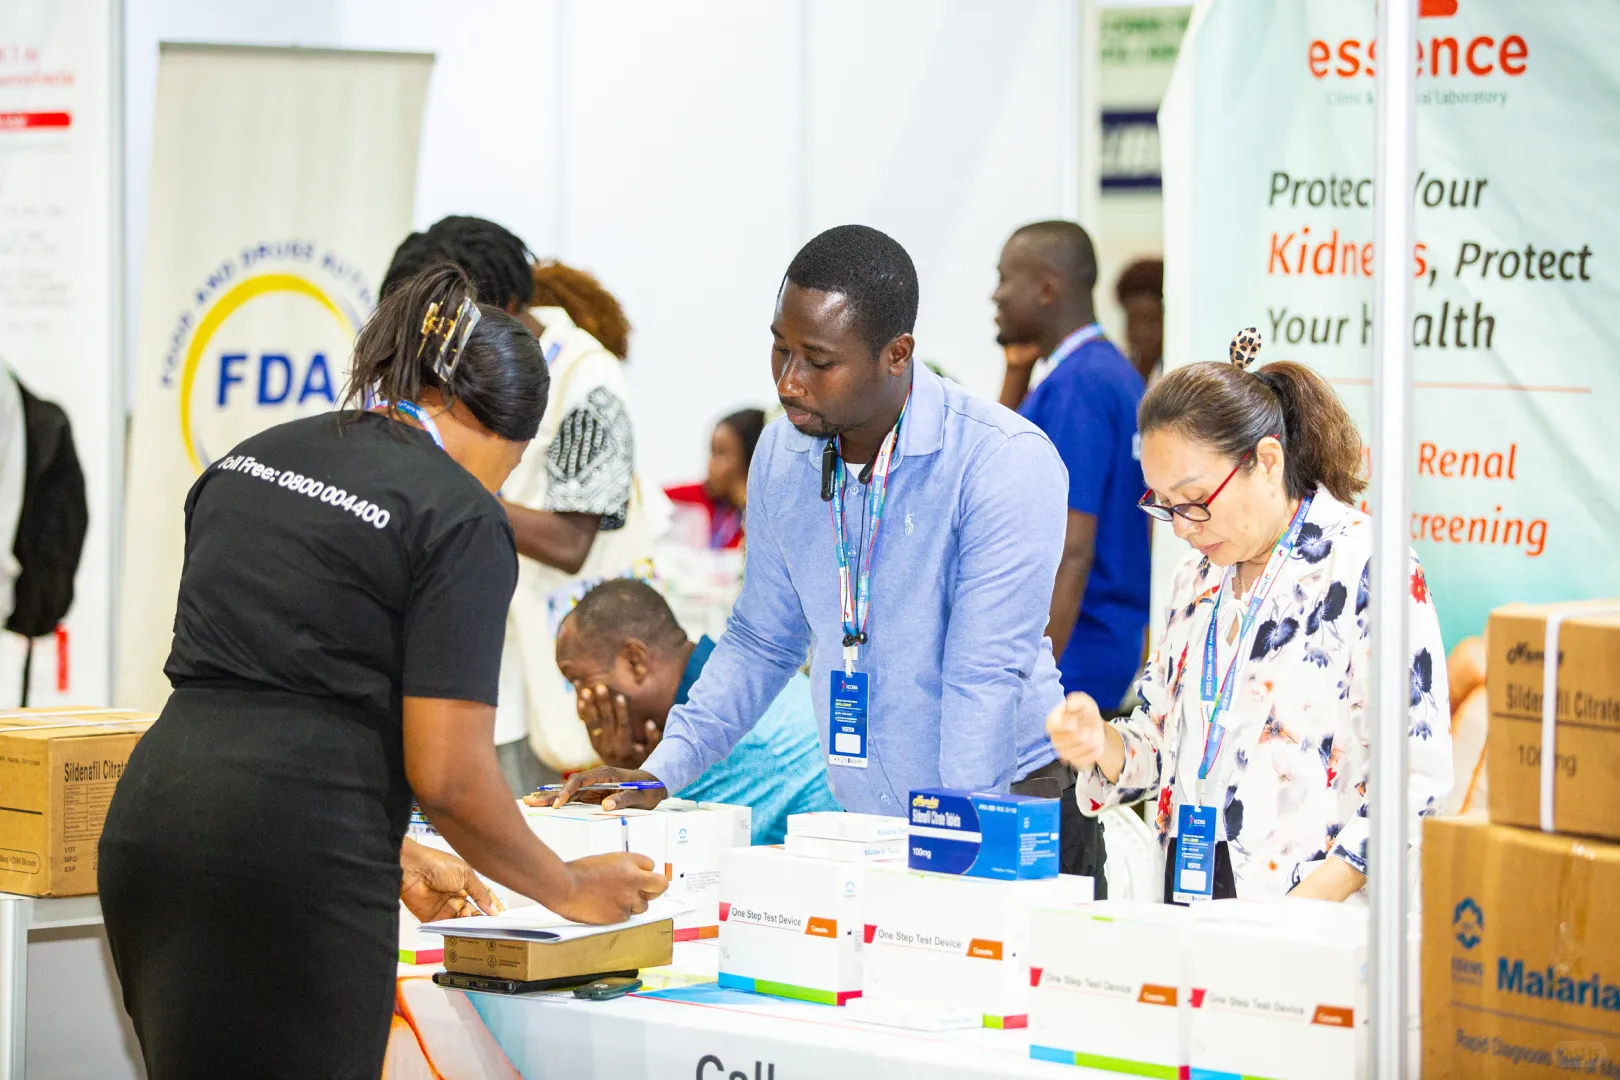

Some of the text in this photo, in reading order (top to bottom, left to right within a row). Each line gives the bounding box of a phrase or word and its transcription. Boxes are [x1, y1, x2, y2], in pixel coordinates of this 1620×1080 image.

[1307, 33, 1529, 79] esnce
[1436, 89, 1508, 107] Laboratory
[1267, 170, 1375, 208] Protec
[1266, 227, 1593, 290] Kidnes, Protect
[1266, 305, 1349, 345] Your
[216, 353, 338, 407] FDA
[1417, 442, 1517, 480] Renal
[238, 456, 281, 482] Free:
[278, 470, 324, 498] 0800
[319, 485, 390, 529] 004400
[64, 759, 127, 782] Sildenafil Citrat
[912, 846, 932, 860] 100mg
[731, 907, 802, 927] One Step Test Device
[878, 929, 962, 949] One Step Test Device
[1497, 956, 1620, 1012] Malaria
